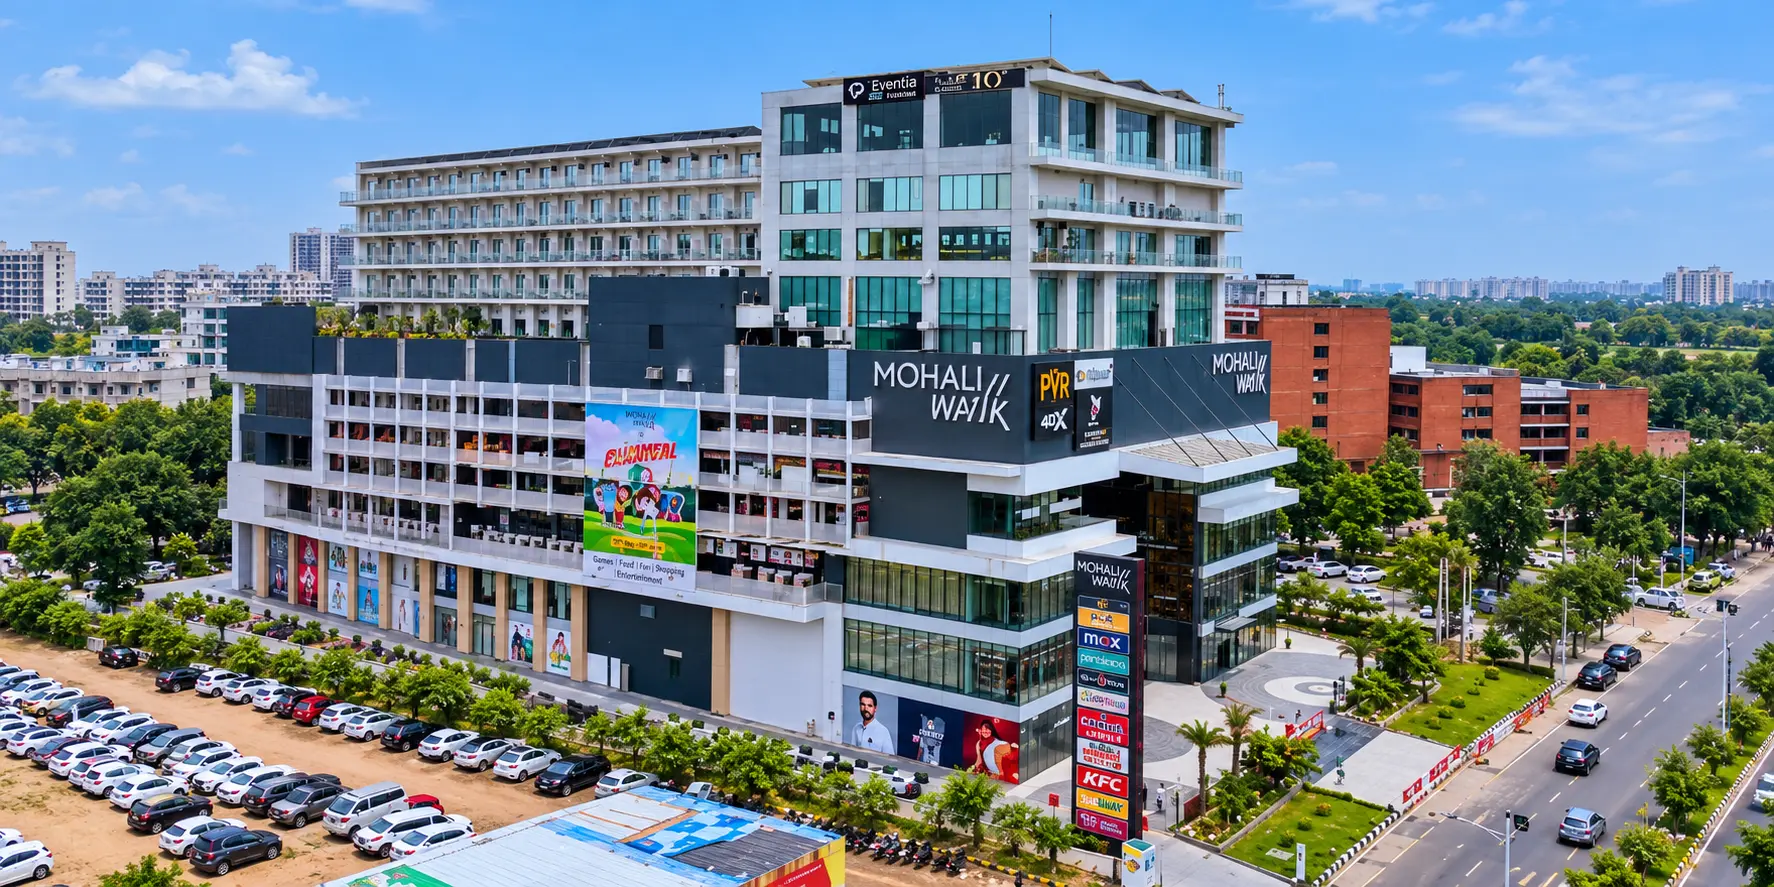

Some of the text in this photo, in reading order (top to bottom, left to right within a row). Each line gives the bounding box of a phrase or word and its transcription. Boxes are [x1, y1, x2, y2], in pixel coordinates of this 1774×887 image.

[872, 75, 917, 92] Eventia
[1213, 351, 1258, 375] MOHALI
[873, 361, 982, 392] MOHALI
[1040, 368, 1070, 402] PVR
[1040, 407, 1069, 431] 4DX
[1077, 560, 1120, 577] MOHALI
[1083, 771, 1122, 791] KFC
